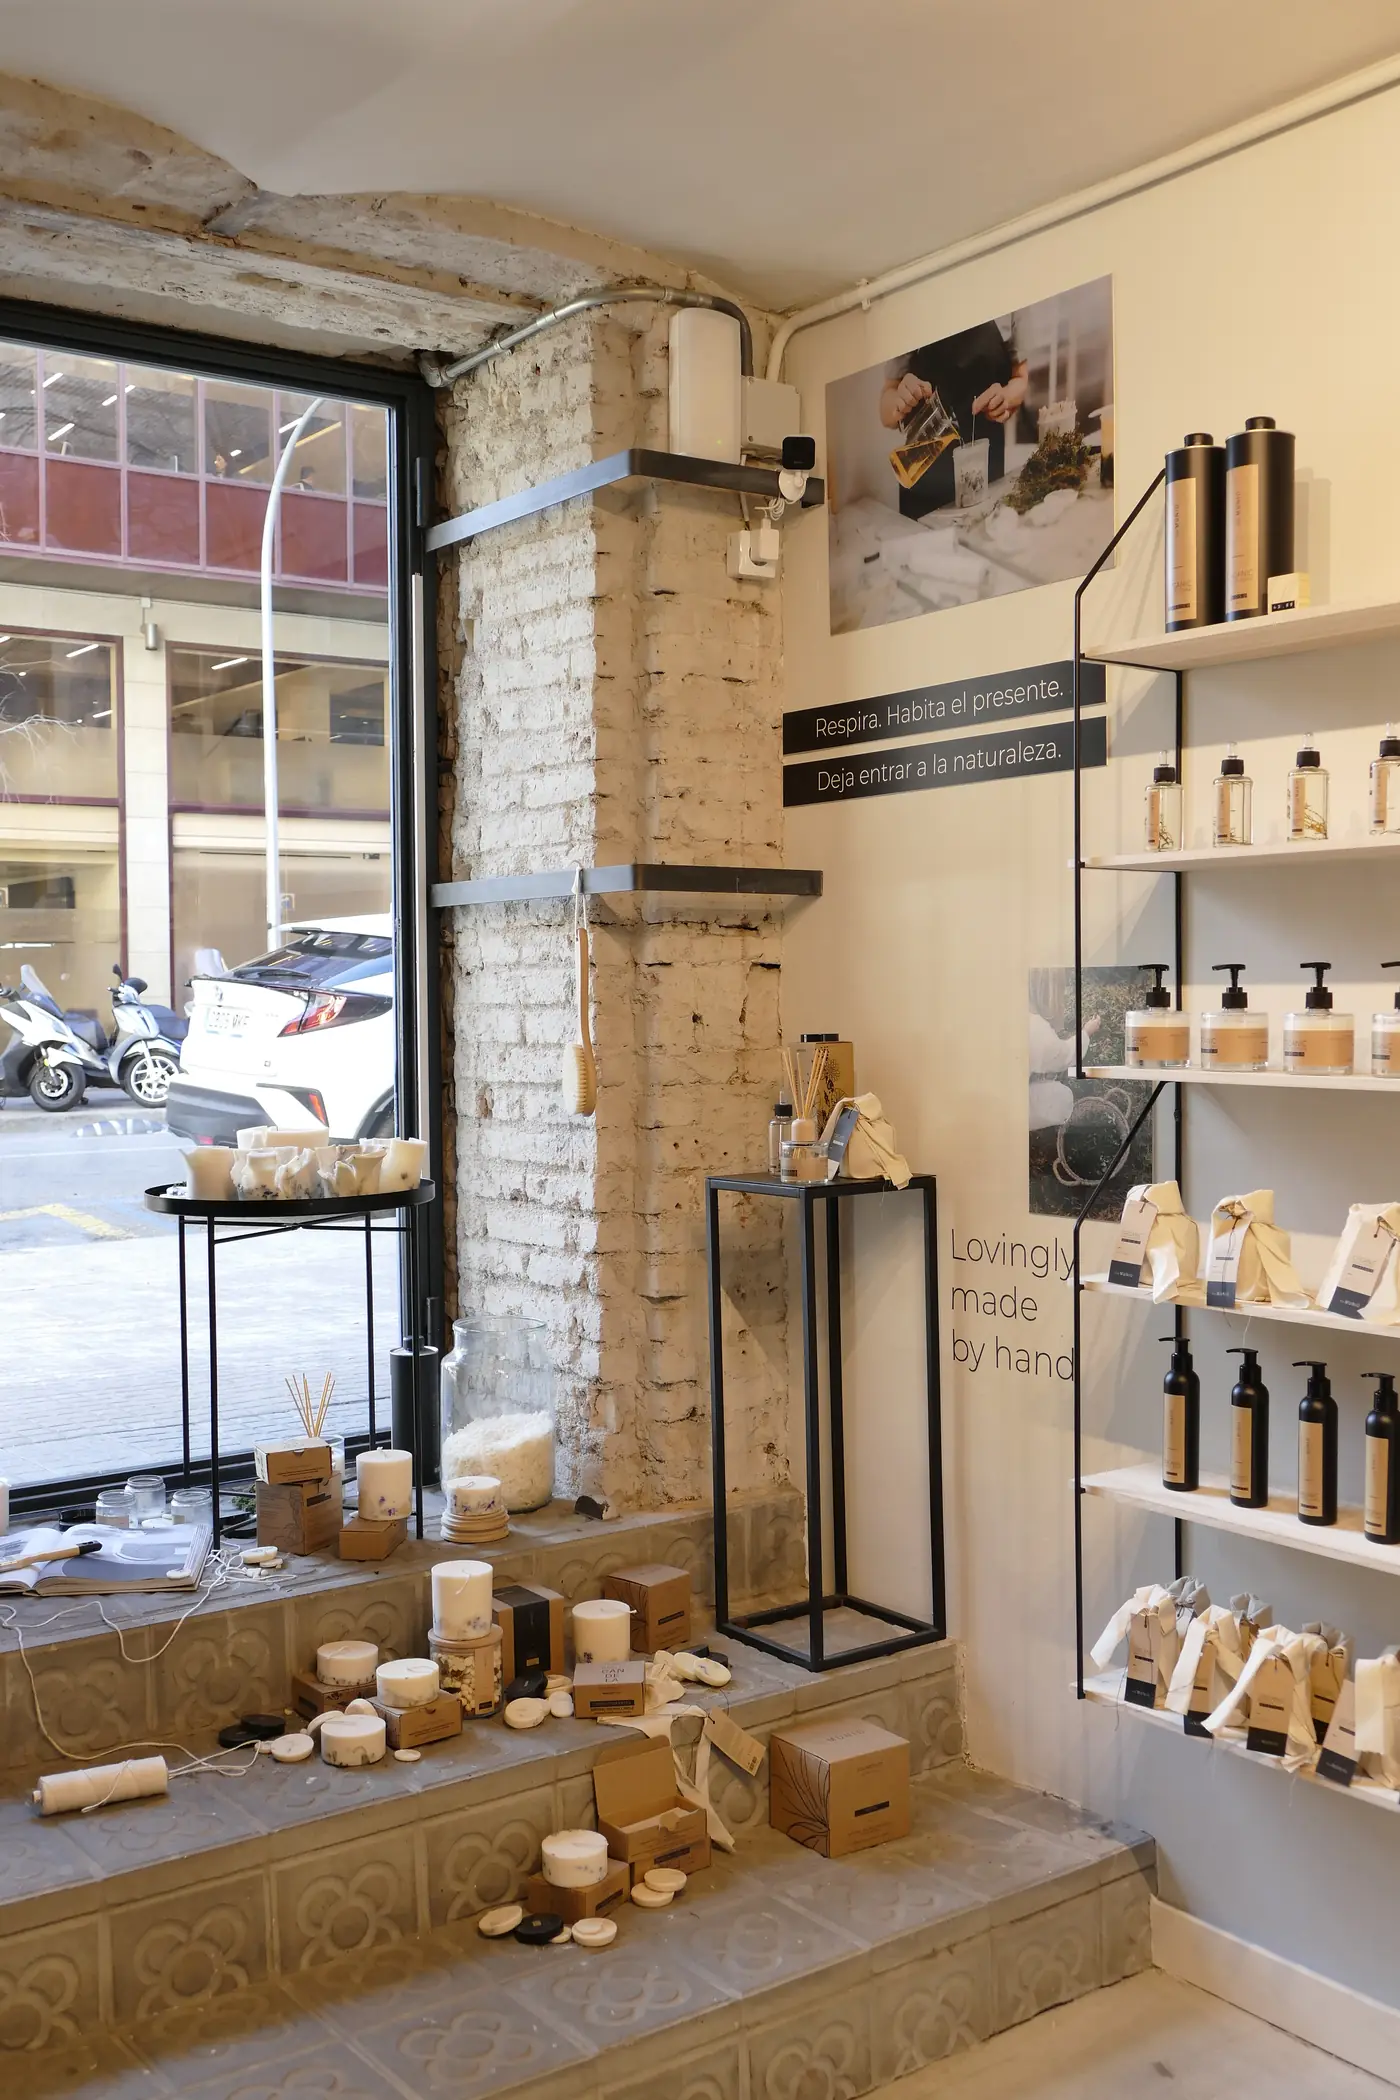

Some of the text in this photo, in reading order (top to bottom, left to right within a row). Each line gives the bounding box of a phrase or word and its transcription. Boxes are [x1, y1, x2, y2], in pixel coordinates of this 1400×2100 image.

[815, 678, 1064, 738] Respira. Habita el presente.
[818, 741, 1062, 793] Deja entrar a la naturaleza.
[951, 1228, 1075, 1281] Lovingly
[951, 1286, 1038, 1321] made
[952, 1328, 1075, 1381] by hand
